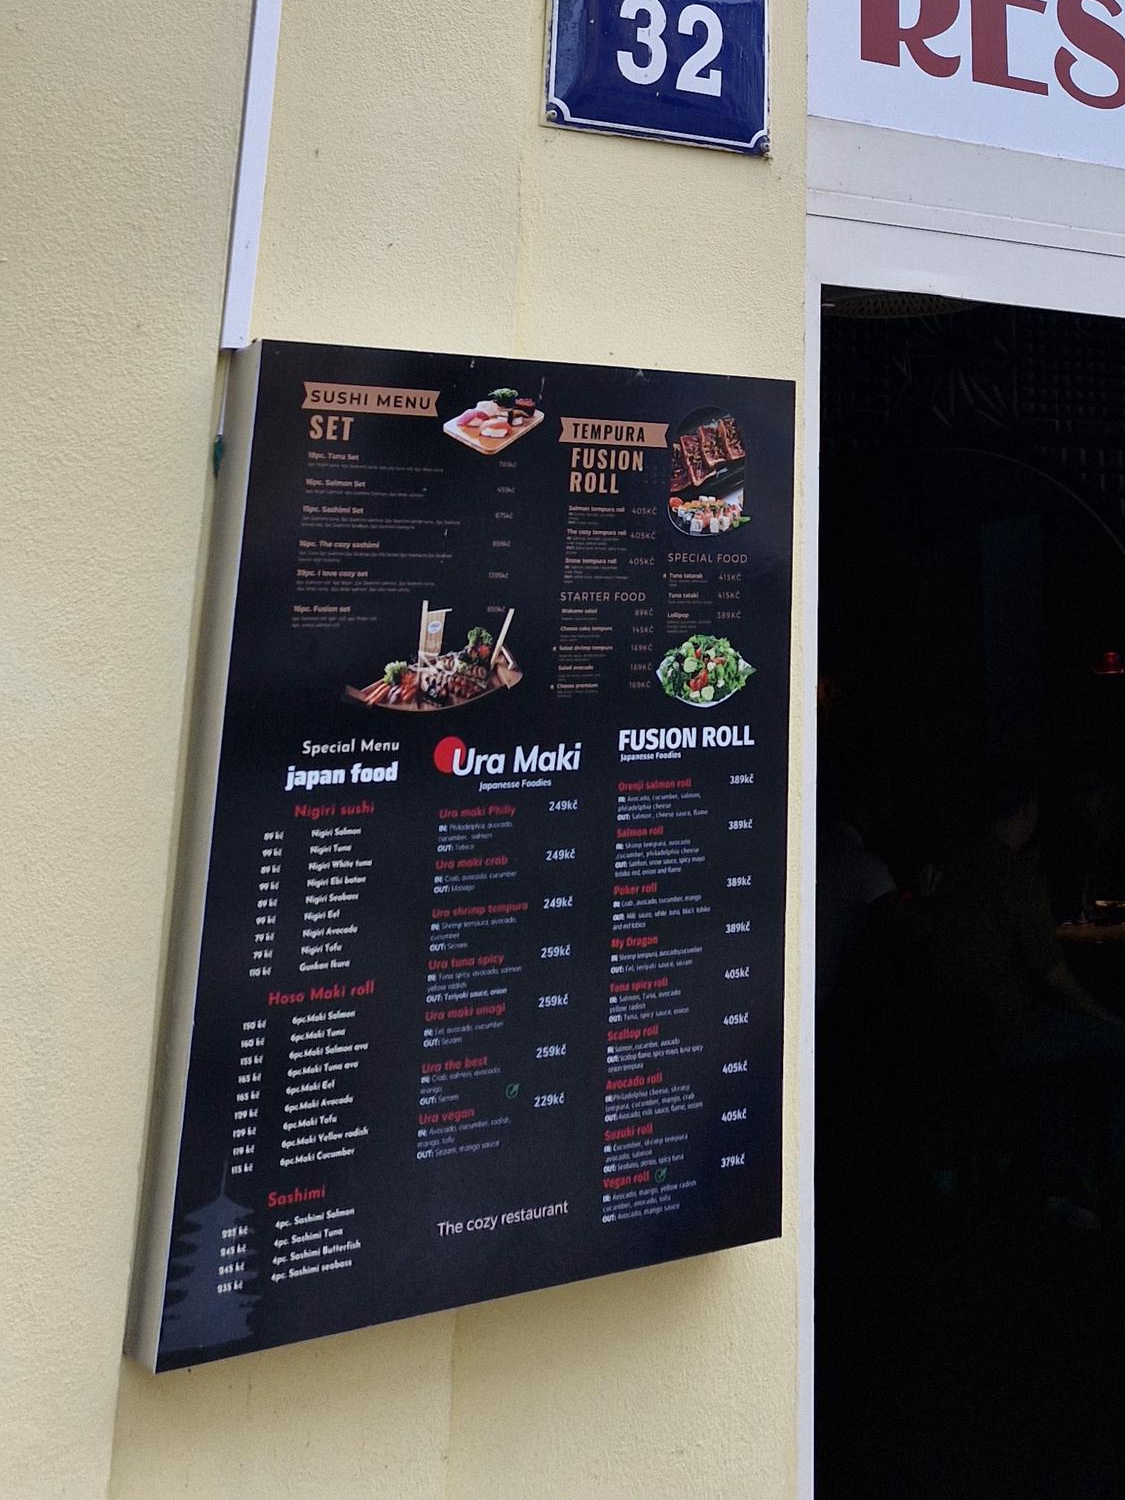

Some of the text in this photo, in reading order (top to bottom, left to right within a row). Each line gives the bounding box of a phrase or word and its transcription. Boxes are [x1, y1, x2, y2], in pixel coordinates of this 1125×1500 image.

[311, 389, 431, 410] SUSHI MENU
[309, 414, 354, 442] SET
[573, 423, 645, 442] TEMPURA
[571, 447, 644, 471] FUSION
[570, 470, 619, 494] ROLL
[668, 552, 748, 563] SPECIAL FOOD
[560, 592, 646, 602] STARTER FOOD
[619, 725, 754, 751] FUSION ROLL
[302, 739, 400, 758] Special Menu
[452, 743, 582, 776] Ura Maki
[285, 761, 398, 791] japan food
[730, 774, 754, 785] 389kč
[618, 778, 692, 792] Orenji salmon roll
[294, 800, 374, 820] Nigiri sushi
[439, 805, 516, 819] Ura maki Philly
[549, 800, 578, 812] 249kč
[617, 827, 663, 838] Salmon roll
[728, 819, 753, 831] 389kč
[546, 849, 575, 861] 249kč
[436, 856, 508, 870] Ura maki crab
[613, 883, 657, 896] Poker roll
[726, 876, 751, 888] 389kč
[432, 902, 528, 918] Ura shrimp tempura
[544, 896, 573, 909] 249kč
[726, 922, 750, 934] 389kč
[541, 945, 570, 959] 259kč
[428, 954, 504, 970] Ura tuna spicy
[725, 967, 749, 979] 405kč
[268, 980, 374, 1006] Hoso Maki roll
[610, 978, 668, 993] Tuna spicy roll
[538, 994, 569, 1008] 259kč
[426, 1003, 506, 1022] Ura maki unagi
[723, 1013, 748, 1025] 405kč
[608, 1026, 659, 1042] Scallop roll
[536, 1044, 566, 1058] 259kč
[422, 1056, 488, 1074] Ura the best
[722, 1061, 748, 1074] 405kč
[606, 1073, 662, 1090] Avocado roll
[534, 1092, 564, 1107] 229kč
[419, 1108, 474, 1124] Ura vegan
[721, 1109, 747, 1122] 405kč
[605, 1124, 653, 1142] Suzuki roll
[721, 1154, 745, 1168] 379kč
[603, 1171, 650, 1190] Vegan roll
[267, 1185, 326, 1207] Sashimi
[438, 1201, 569, 1237] The cozy restaurant
